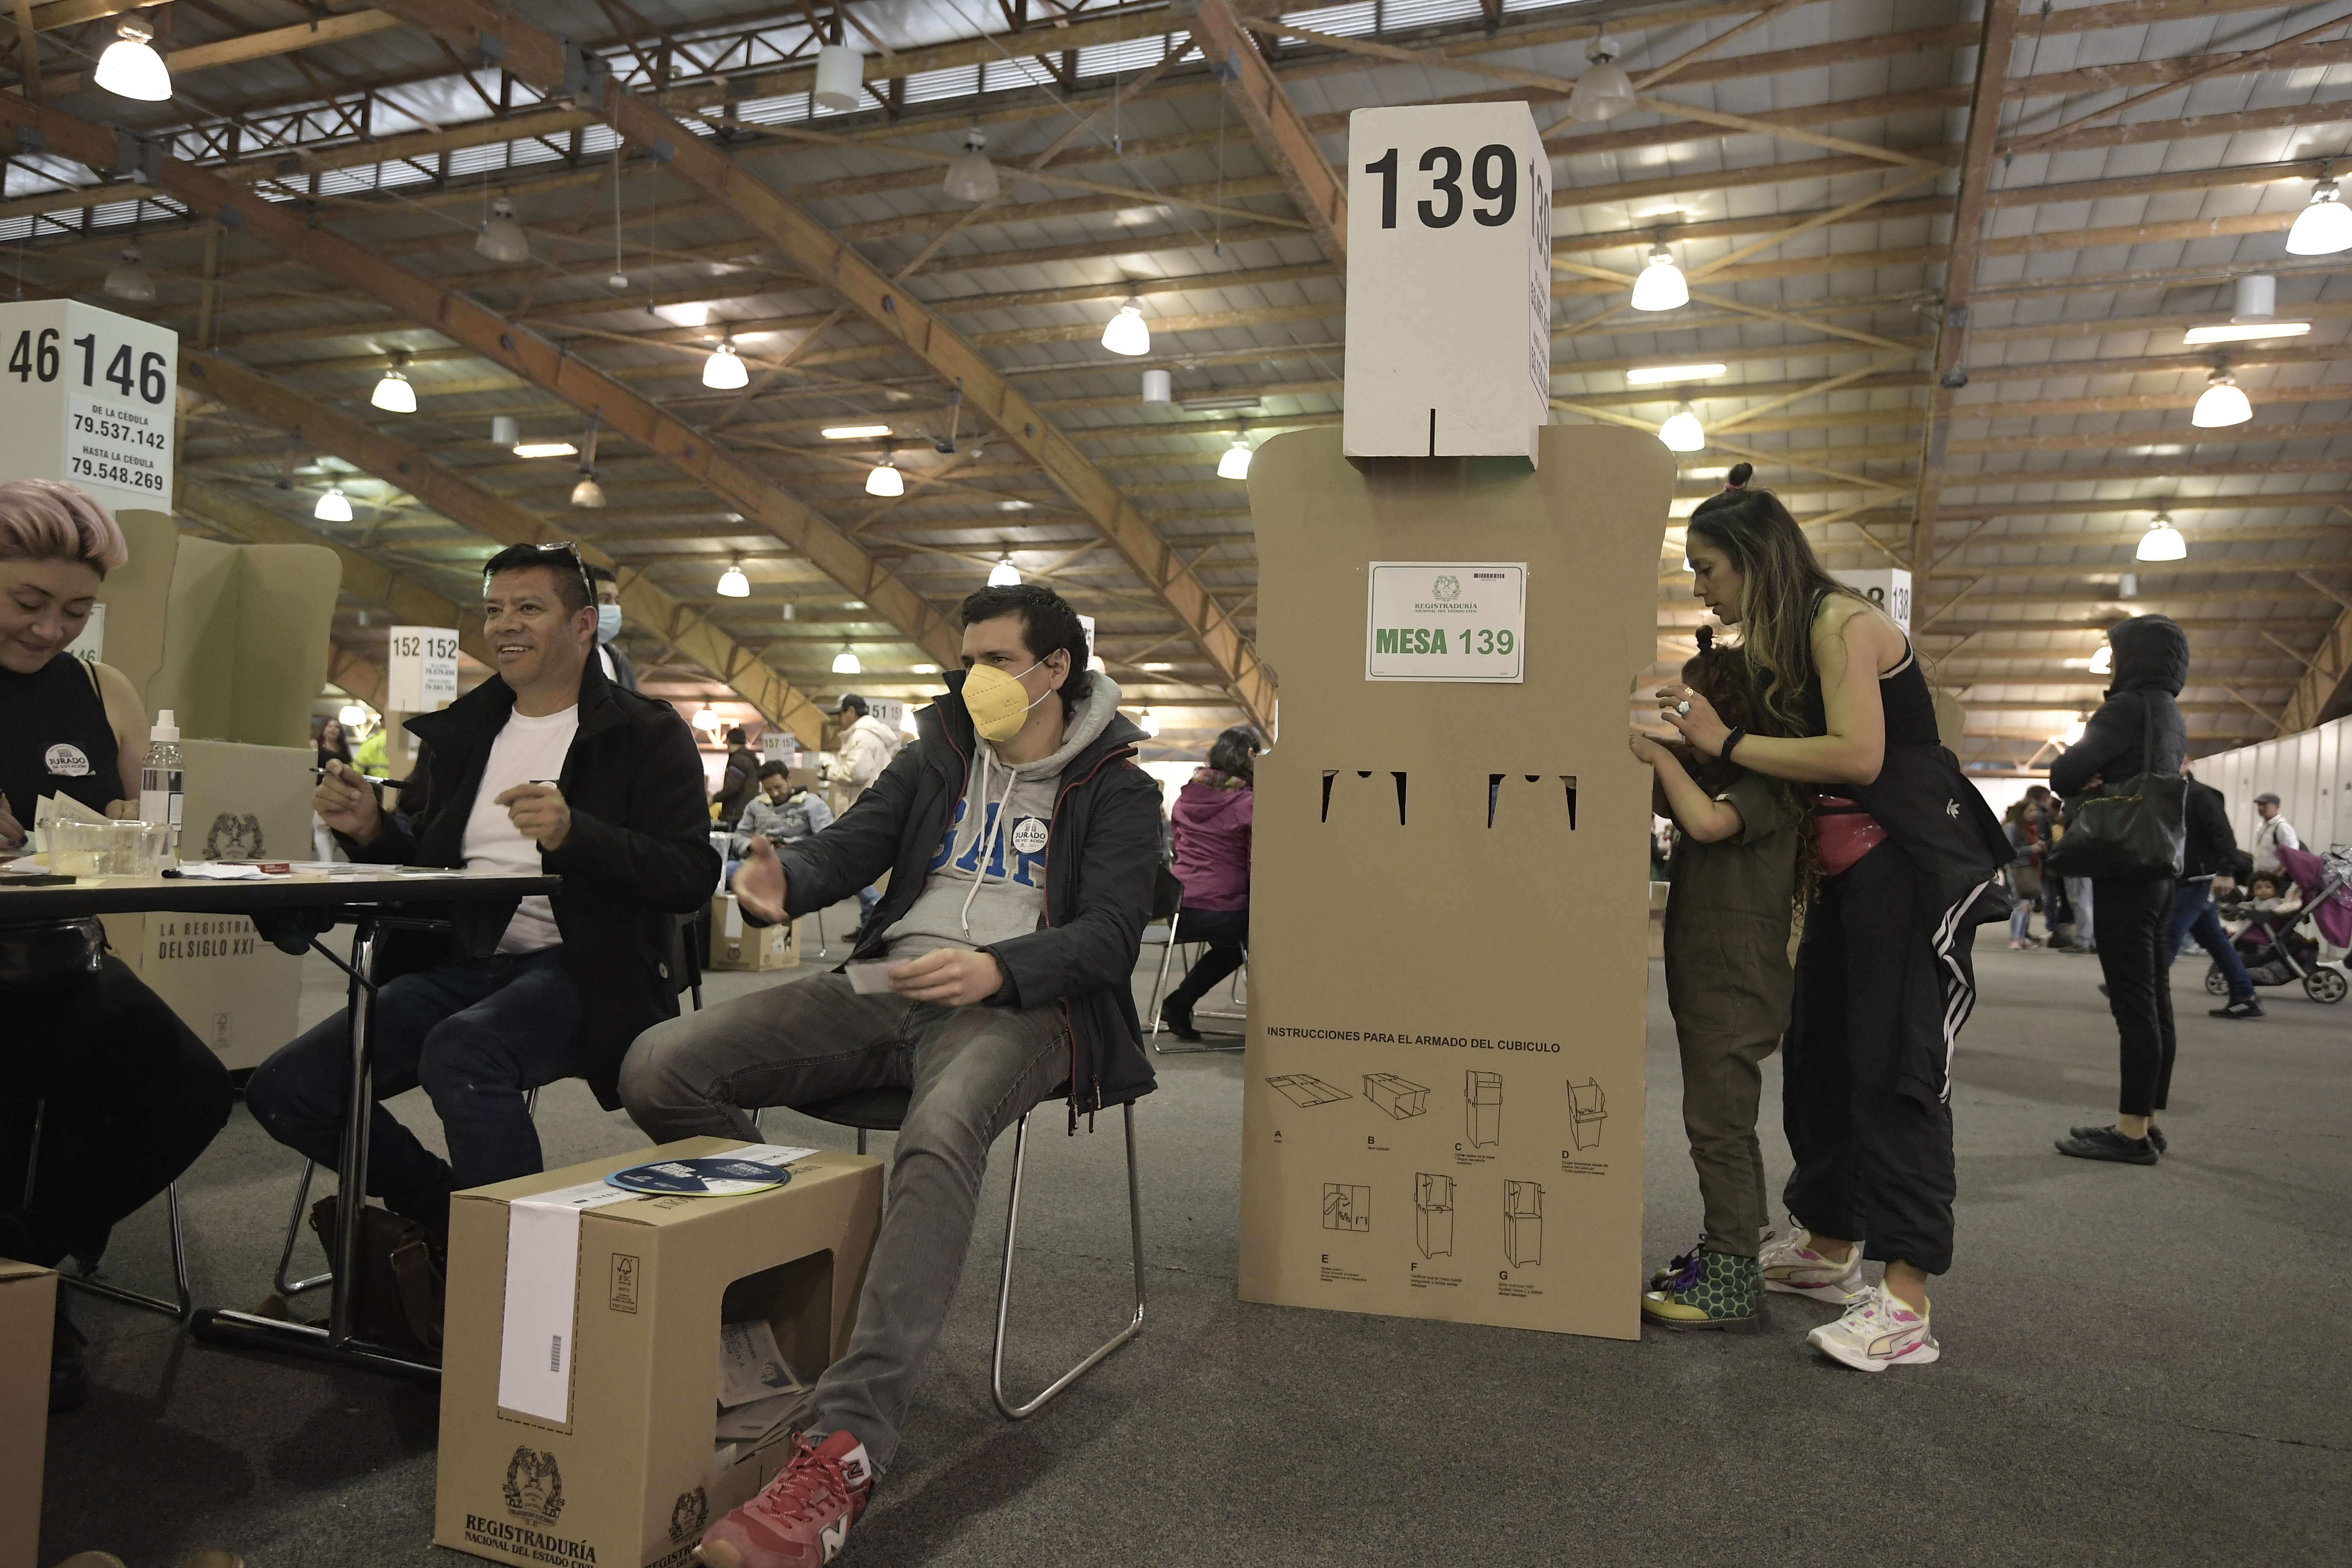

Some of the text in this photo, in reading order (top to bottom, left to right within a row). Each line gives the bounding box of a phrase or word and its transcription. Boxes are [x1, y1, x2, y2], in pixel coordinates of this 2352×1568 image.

[1365, 144, 1517, 229] 139
[1529, 157, 1549, 272] 139
[0, 328, 60, 383] 46
[74, 333, 166, 405] 146
[93, 405, 103, 414] DE
[106, 408, 115, 417] LA
[74, 414, 165, 450] 79.537.142
[83, 446, 109, 458] HASTA
[112, 452, 121, 461] LA
[72, 457, 163, 490] 79.548.269
[1893, 586, 1908, 620] 138
[394, 637, 420, 656] 152
[427, 638, 457, 659] 152
[1376, 628, 1514, 655] MESA 139
[765, 738, 779, 748] 157
[161, 923, 174, 936] LA
[234, 938, 254, 955] XXI
[1267, 1027, 1560, 1053] INSTRUCCIONES PARA EL ARMADO DEL CUBICULO
[1322, 1254, 1328, 1263] E
[1411, 1263, 1417, 1271] F
[1499, 1271, 1508, 1280] G
[465, 1531, 509, 1551] NACIONAL
[512, 1544, 530, 1557] DEL
[533, 1549, 569, 1567] ESTADO
[466, 1514, 597, 1563] REGISTRADURÍA
